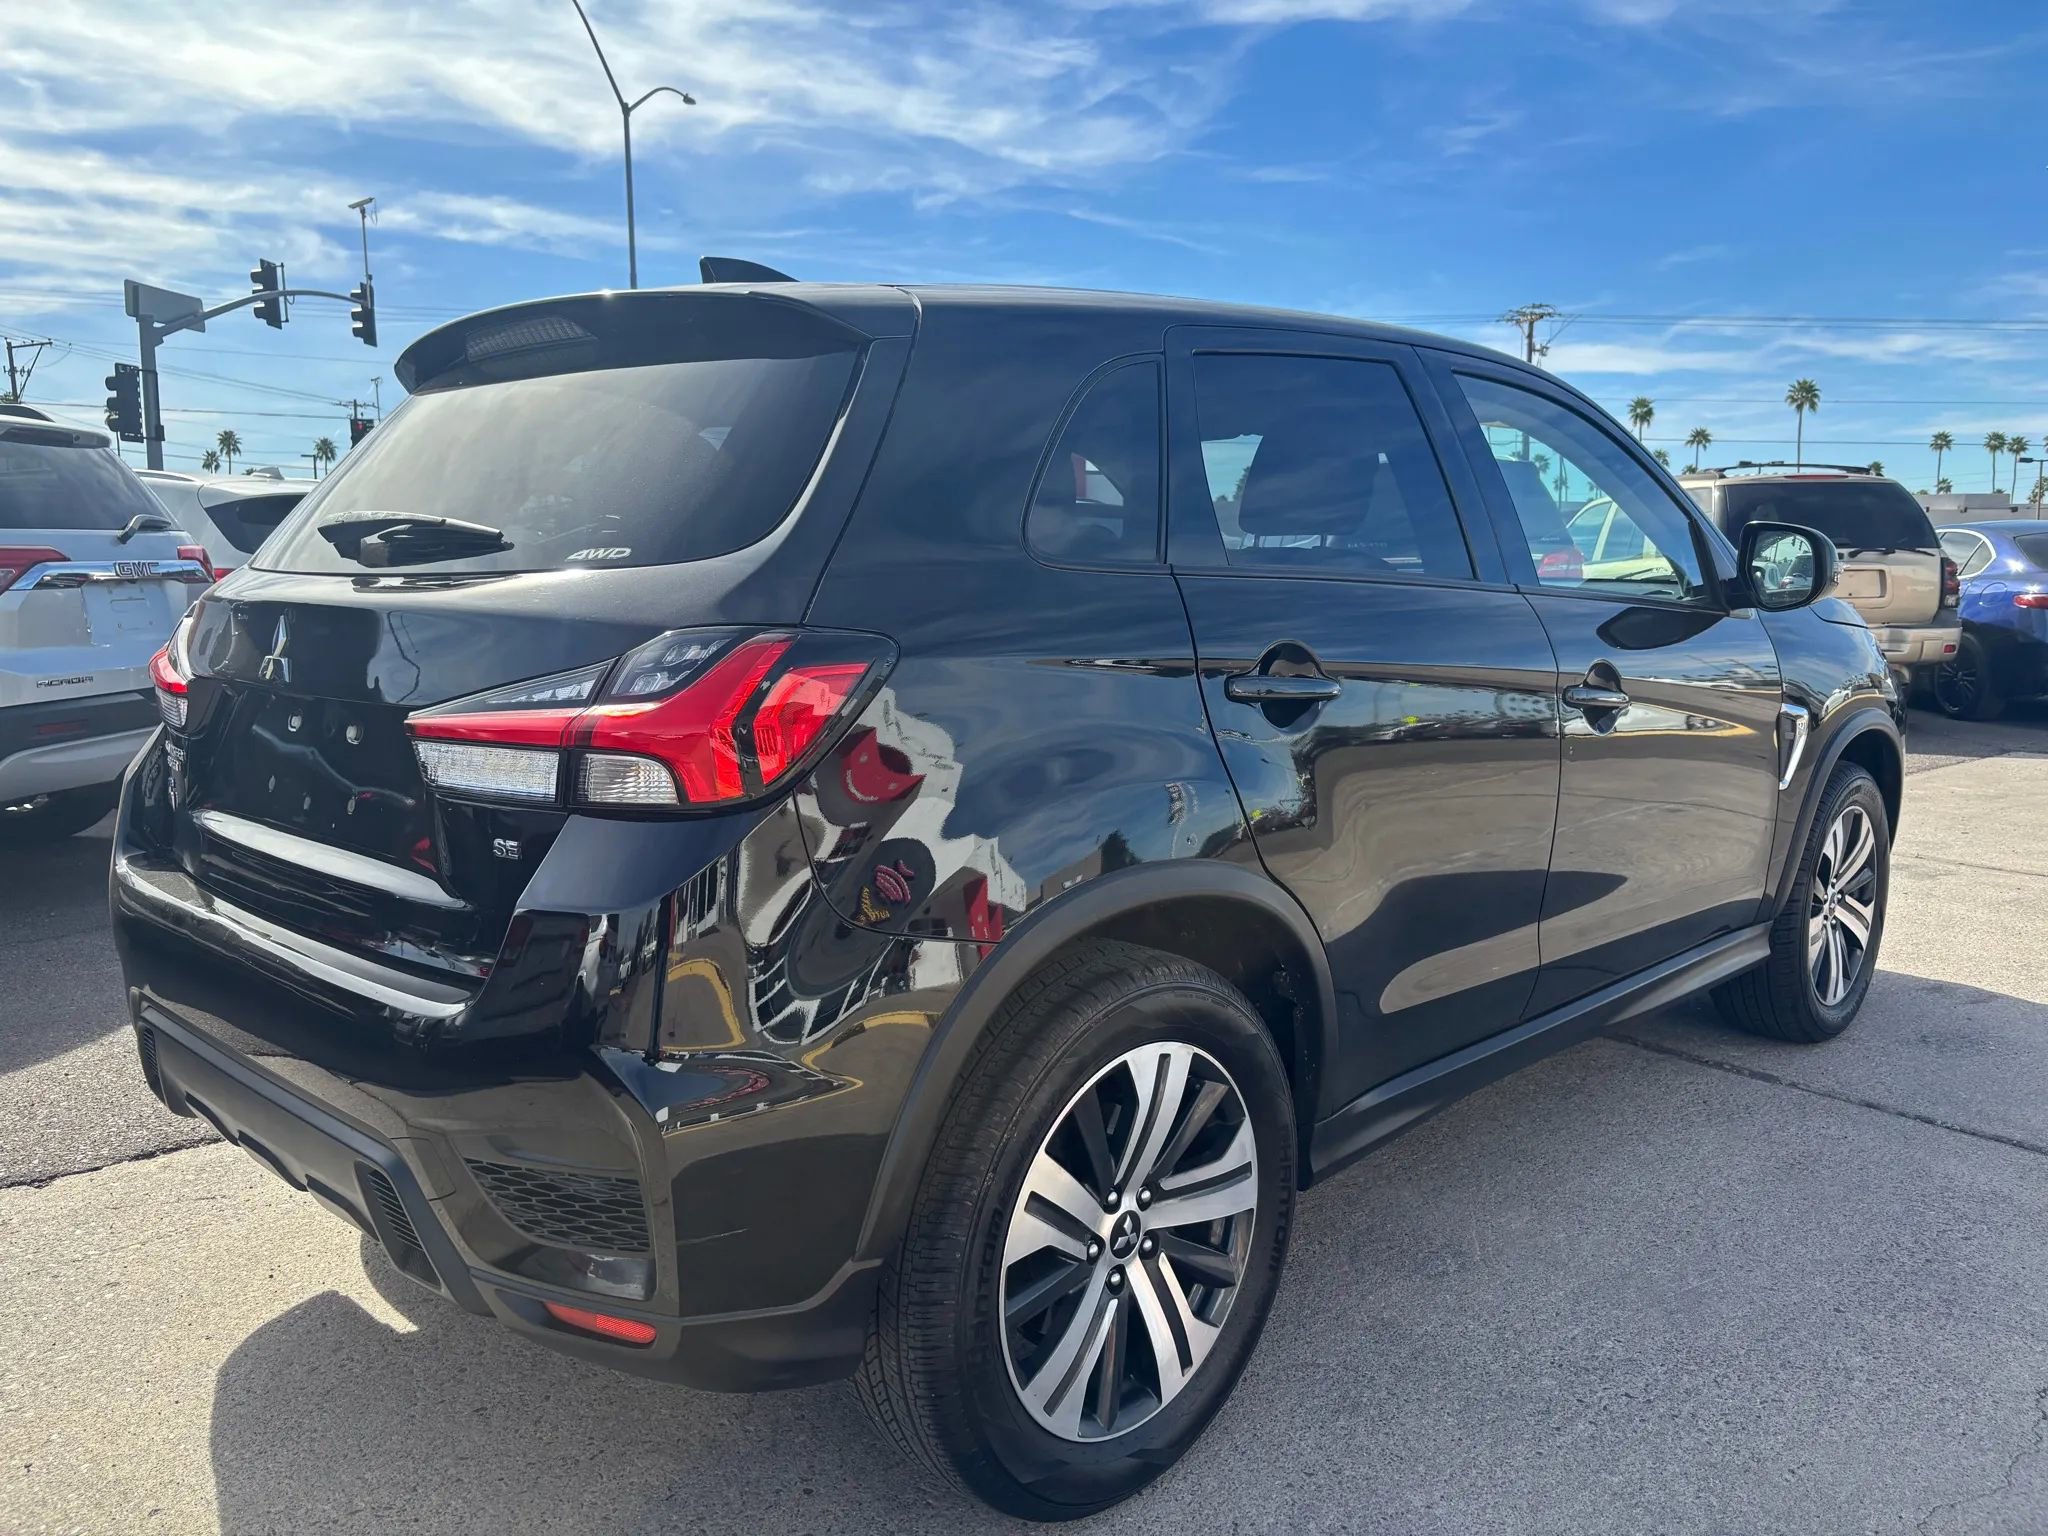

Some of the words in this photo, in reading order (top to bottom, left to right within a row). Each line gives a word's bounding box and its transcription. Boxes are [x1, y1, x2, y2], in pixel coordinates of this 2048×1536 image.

[564, 547, 632, 562] 4WD
[113, 561, 160, 577] GMC
[493, 838, 522, 859] SE
